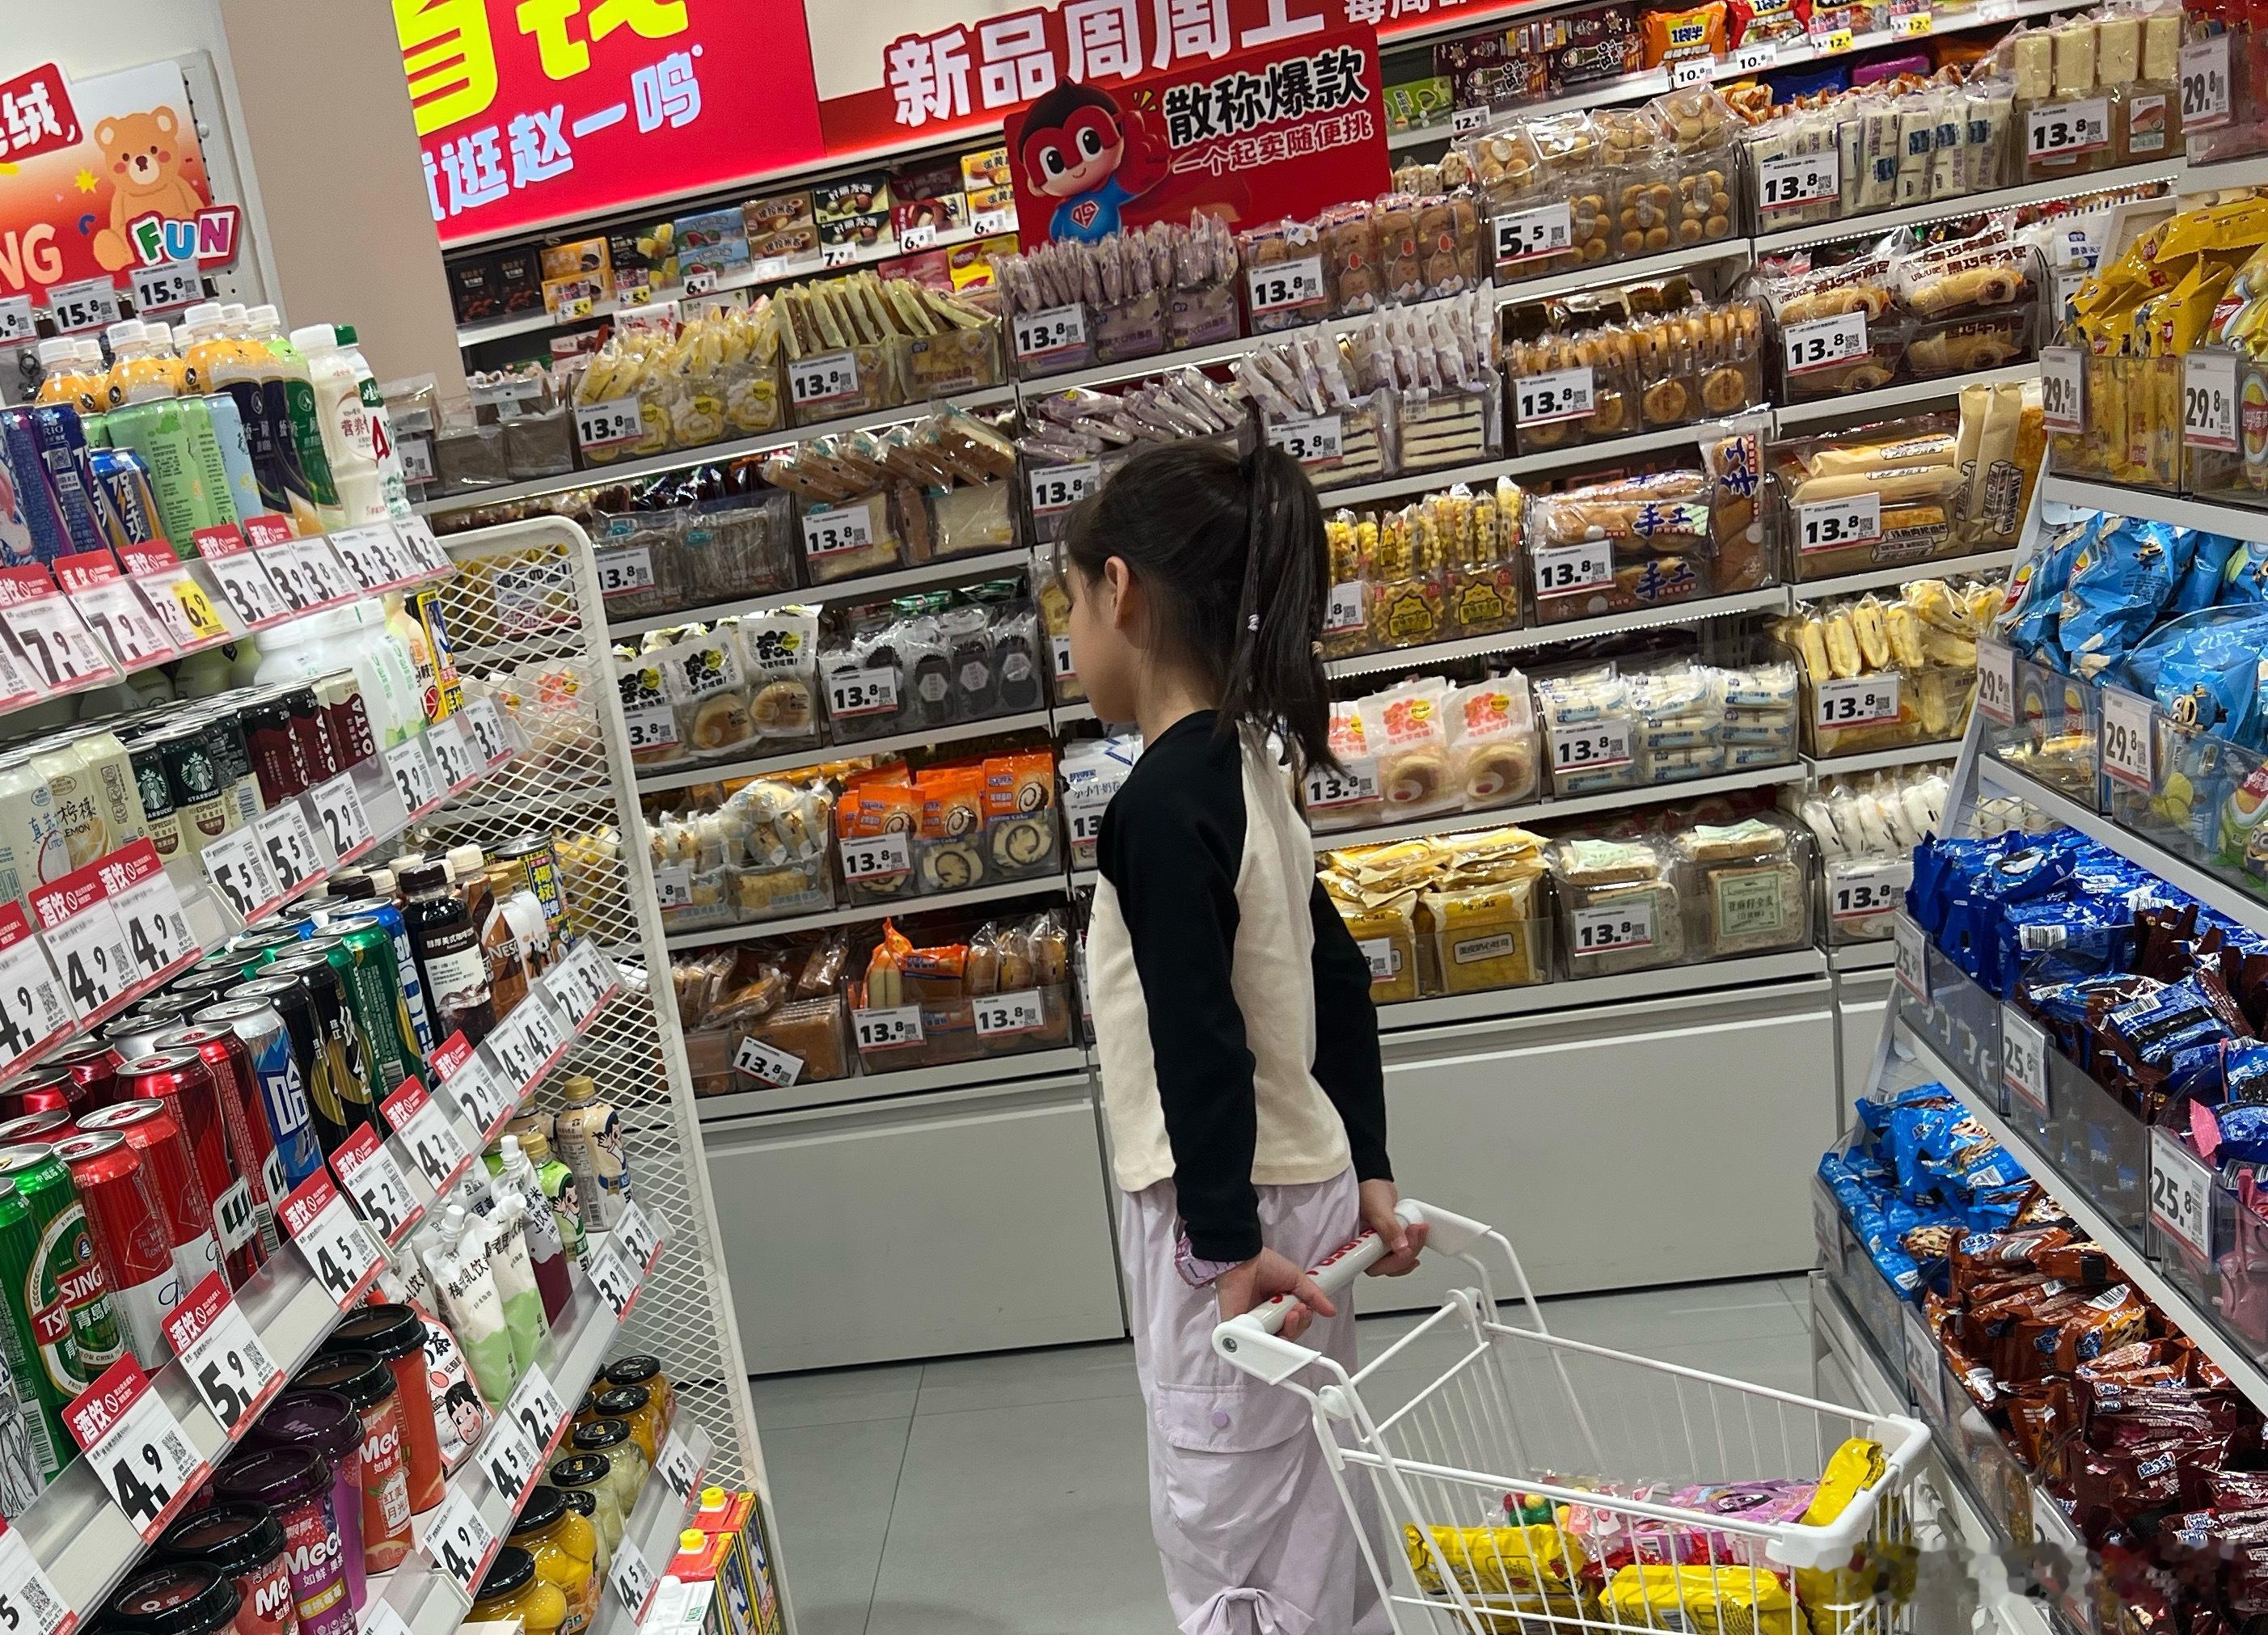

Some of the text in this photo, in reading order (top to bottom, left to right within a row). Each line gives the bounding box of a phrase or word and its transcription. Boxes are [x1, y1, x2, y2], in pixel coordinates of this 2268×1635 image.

[1164, 46, 1368, 148] 散称爆款
[2182, 70, 2216, 115] 29.8
[421, 52, 701, 221] 逛赵一鸣
[1172, 112, 1375, 175] 一个起卖随便挑
[2033, 119, 2087, 150] 13.8
[1765, 172, 1818, 202] 13.8
[136, 217, 230, 265] FUN
[1499, 226, 1544, 257] 5.5
[141, 277, 183, 306] 15.8
[1255, 277, 1304, 306] 13.8
[57, 298, 99, 330] 15.8
[1019, 322, 1065, 350] 13.8
[1790, 332, 1844, 365] 13.8
[795, 370, 839, 397] 13.8
[1522, 387, 1573, 416] 13.8
[2042, 376, 2071, 415] 29.8
[2186, 387, 2220, 429] 29.8
[581, 416, 623, 445] 13.8
[1285, 434, 1323, 458] 3.8
[1036, 479, 1083, 505] 13.8
[809, 526, 852, 551] 13.8
[1632, 503, 1693, 539] 手工
[1806, 517, 1859, 544] 13.8
[343, 550, 375, 589] 3.4
[371, 544, 402, 581] 3.5
[406, 534, 433, 572] 4.2
[271, 566, 308, 610] 3.9
[302, 560, 337, 600] 3.8
[1540, 560, 1591, 587] 13.8
[1634, 561, 1696, 601] 手工
[181, 594, 208, 628] 6.9
[225, 579, 264, 623] 3.9
[19, 628, 78, 686] 7.9
[87, 612, 141, 662] 7.9
[834, 685, 878, 709] 13.8
[1977, 666, 2003, 703] 29.8
[352, 698, 374, 756] OSTA
[1822, 694, 1874, 721] 13.8
[316, 713, 336, 773] OSTA
[629, 723, 659, 746] 3.8
[1559, 737, 1608, 763] 13.8
[2105, 722, 2137, 763] 29.8
[289, 727, 309, 787] OSTA
[437, 746, 461, 787] 3.9
[396, 767, 423, 813] 3.9
[1311, 775, 1358, 801] 13.8
[322, 804, 354, 862] 2.9
[98, 862, 130, 896] 酒饮
[267, 835, 302, 887] 5.5
[847, 849, 889, 874] 13.8
[213, 863, 253, 915] 5.5
[1837, 883, 1890, 910] 13.8
[36, 890, 69, 929] 酒饮
[129, 913, 169, 974] 4.9
[487, 937, 518, 961] NESC
[1580, 921, 1631, 946] 13.8
[68, 945, 110, 1012] 4.9
[580, 962, 606, 1001] 3.9
[555, 985, 585, 1029] 2.9
[978, 1005, 1024, 1029] 13.8
[524, 1020, 552, 1057] 4.5
[859, 1020, 904, 1044] 13.8
[500, 1041, 530, 1084] 4.5
[738, 1050, 781, 1078] 13.8
[2005, 1036, 2034, 1083] 25.8
[461, 1085, 496, 1136] 2.9
[336, 1148, 358, 1178] 酒饮
[417, 1133, 451, 1185] 4.2
[285, 1202, 307, 1232] 酒饮
[360, 1182, 399, 1243] 5.2
[2152, 1168, 2192, 1228] 25.8
[315, 1236, 358, 1295] 4.5
[625, 1228, 649, 1270] 3.9
[598, 1273, 626, 1315] 3.9
[170, 1311, 201, 1352] 酒饮
[199, 1350, 253, 1429] 5.9
[73, 1398, 112, 1444] 酒饮
[521, 1397, 553, 1451] 2.2
[359, 1424, 399, 1465] Mec
[112, 1443, 171, 1524] 4.9
[491, 1447, 522, 1504] 4.5
[666, 1457, 692, 1500] 4.5
[441, 1526, 477, 1584] 4.9
[619, 1567, 642, 1611] 4.5
